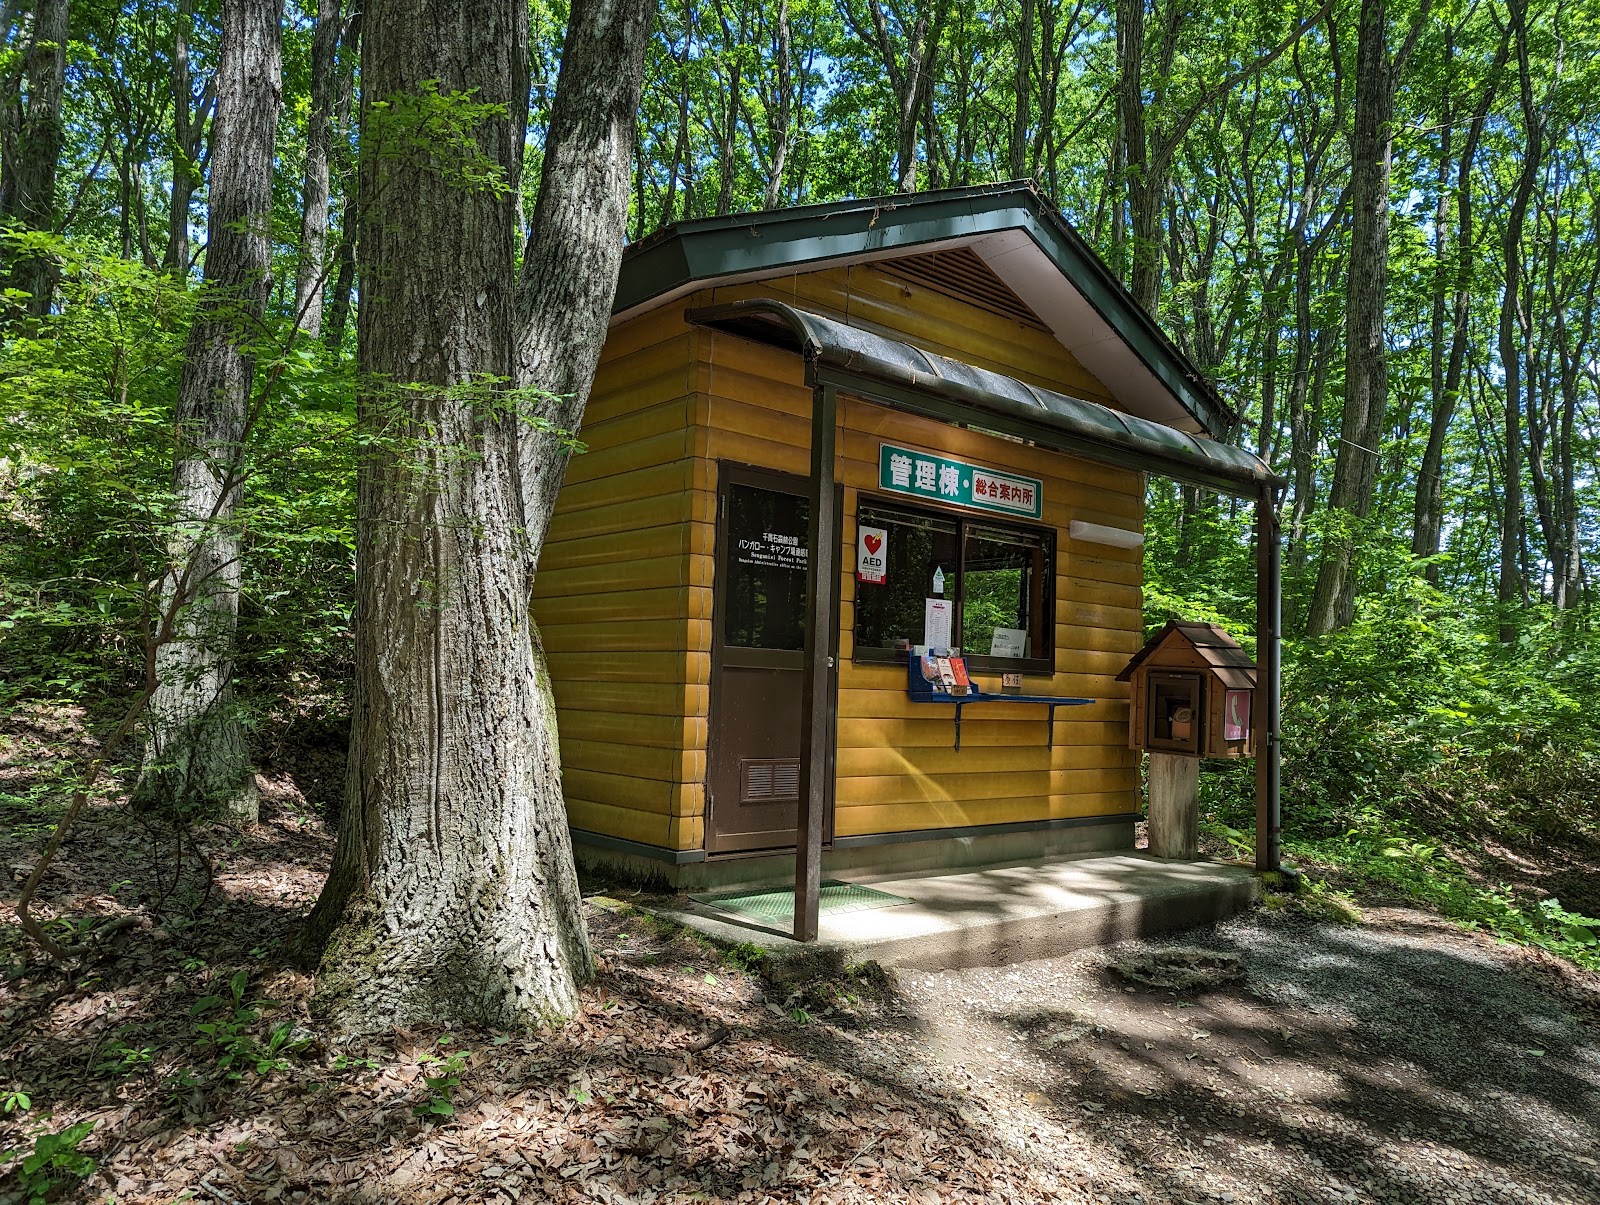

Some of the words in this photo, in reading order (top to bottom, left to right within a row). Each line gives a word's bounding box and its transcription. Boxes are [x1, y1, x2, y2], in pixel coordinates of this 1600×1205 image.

[975, 477, 1034, 506] 総合案内所
[862, 556, 882, 567] AED
